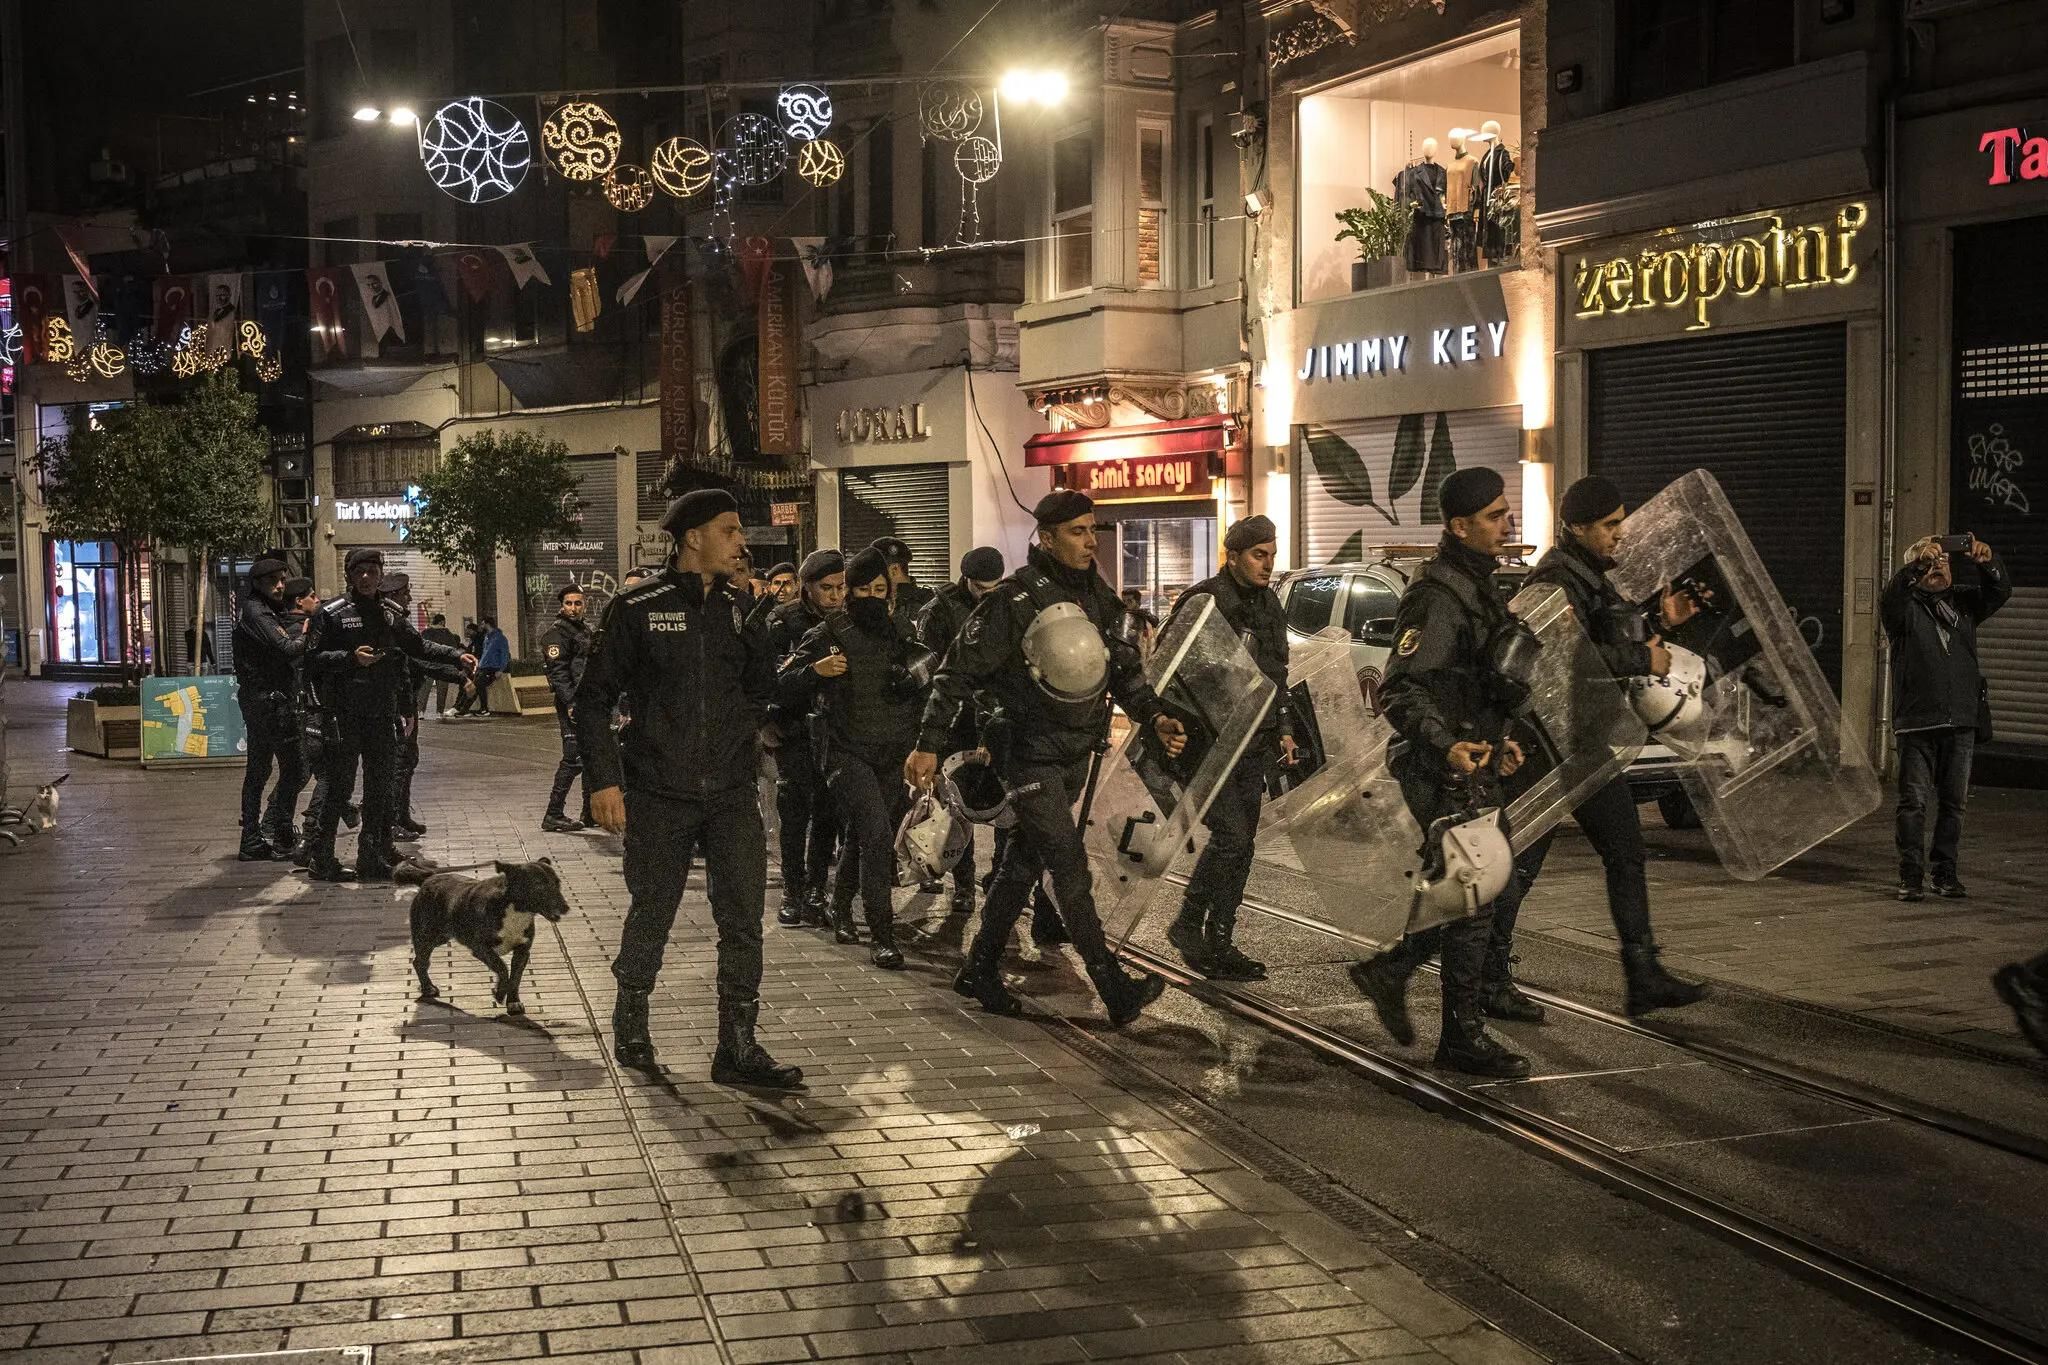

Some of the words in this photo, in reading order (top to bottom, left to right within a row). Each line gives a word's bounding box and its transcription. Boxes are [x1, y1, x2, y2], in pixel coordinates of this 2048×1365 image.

[1573, 202, 1867, 331] zeropoint
[1297, 335, 1406, 380] JIMMY
[1433, 320, 1508, 365] KEY
[768, 375, 788, 443] KÜLTÜR
[1090, 458, 1130, 489] simit
[1135, 461, 1192, 492] sarayı
[335, 501, 361, 520] Türk
[362, 501, 411, 519] Telekom
